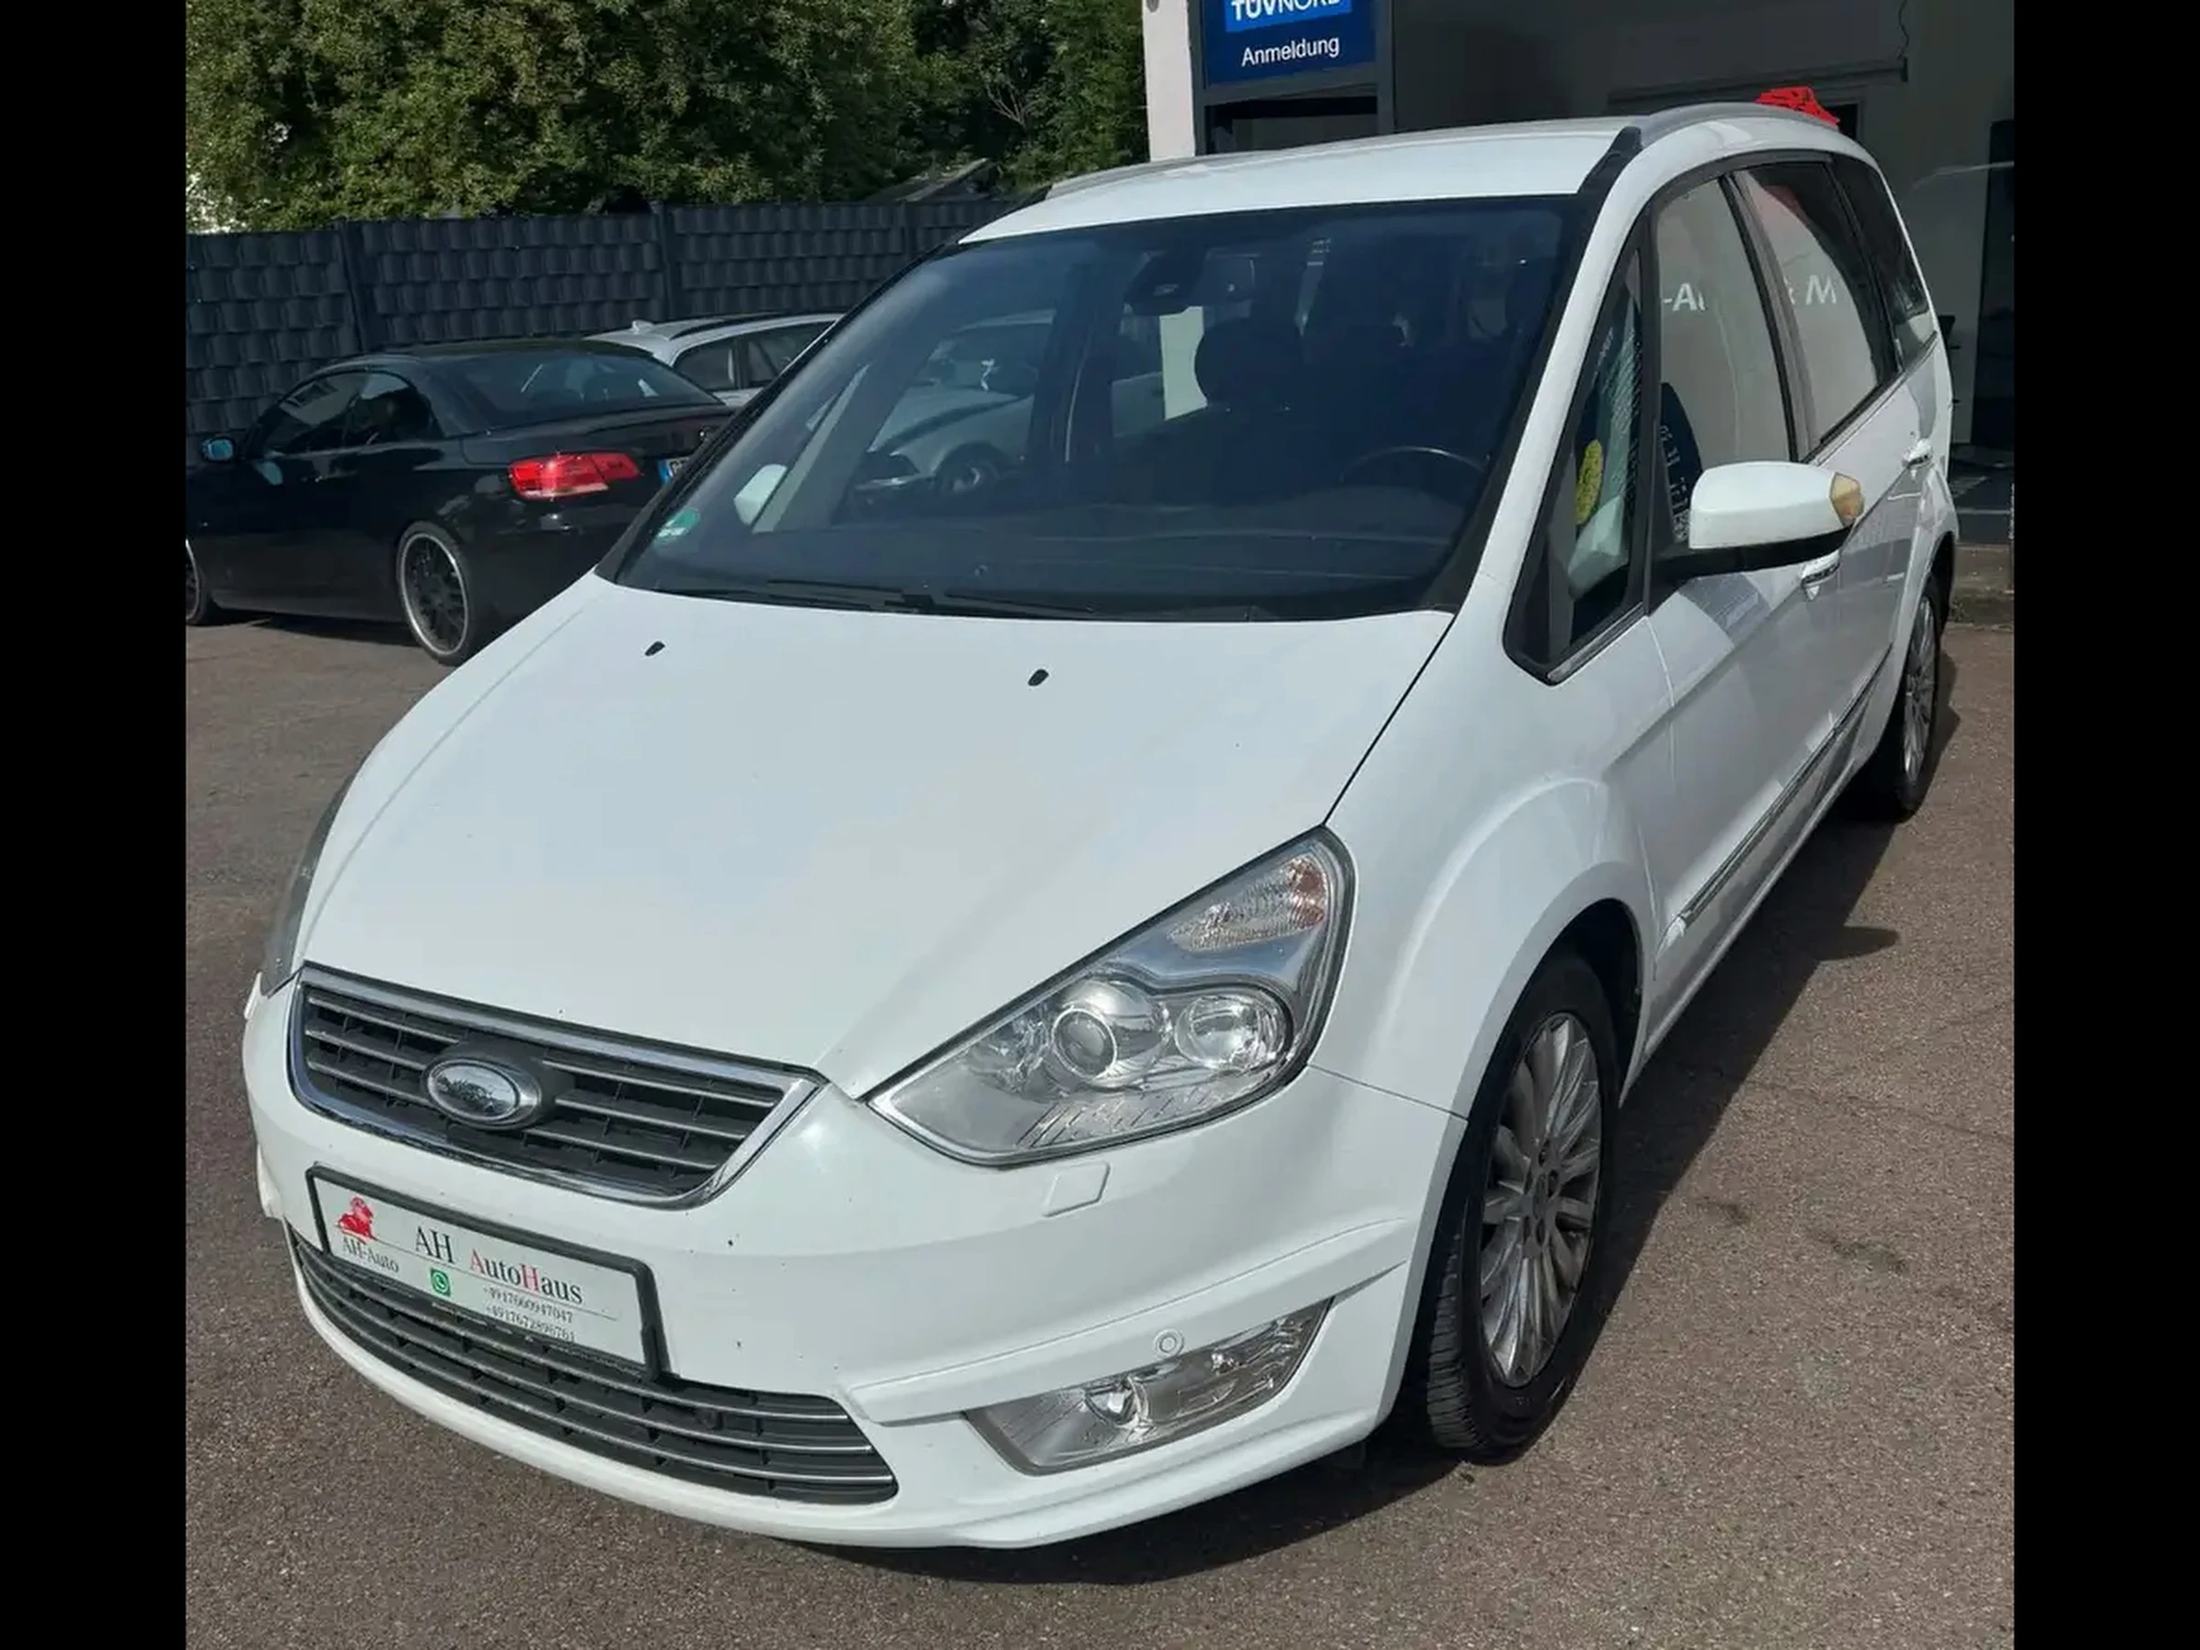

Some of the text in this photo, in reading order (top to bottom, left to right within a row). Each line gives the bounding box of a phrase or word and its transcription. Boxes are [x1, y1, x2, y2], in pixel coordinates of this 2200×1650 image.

[1241, 37, 1340, 67] Anmeldung
[342, 1238, 399, 1274] AH-Auto
[415, 1226, 583, 1304] AH AutoHaus
